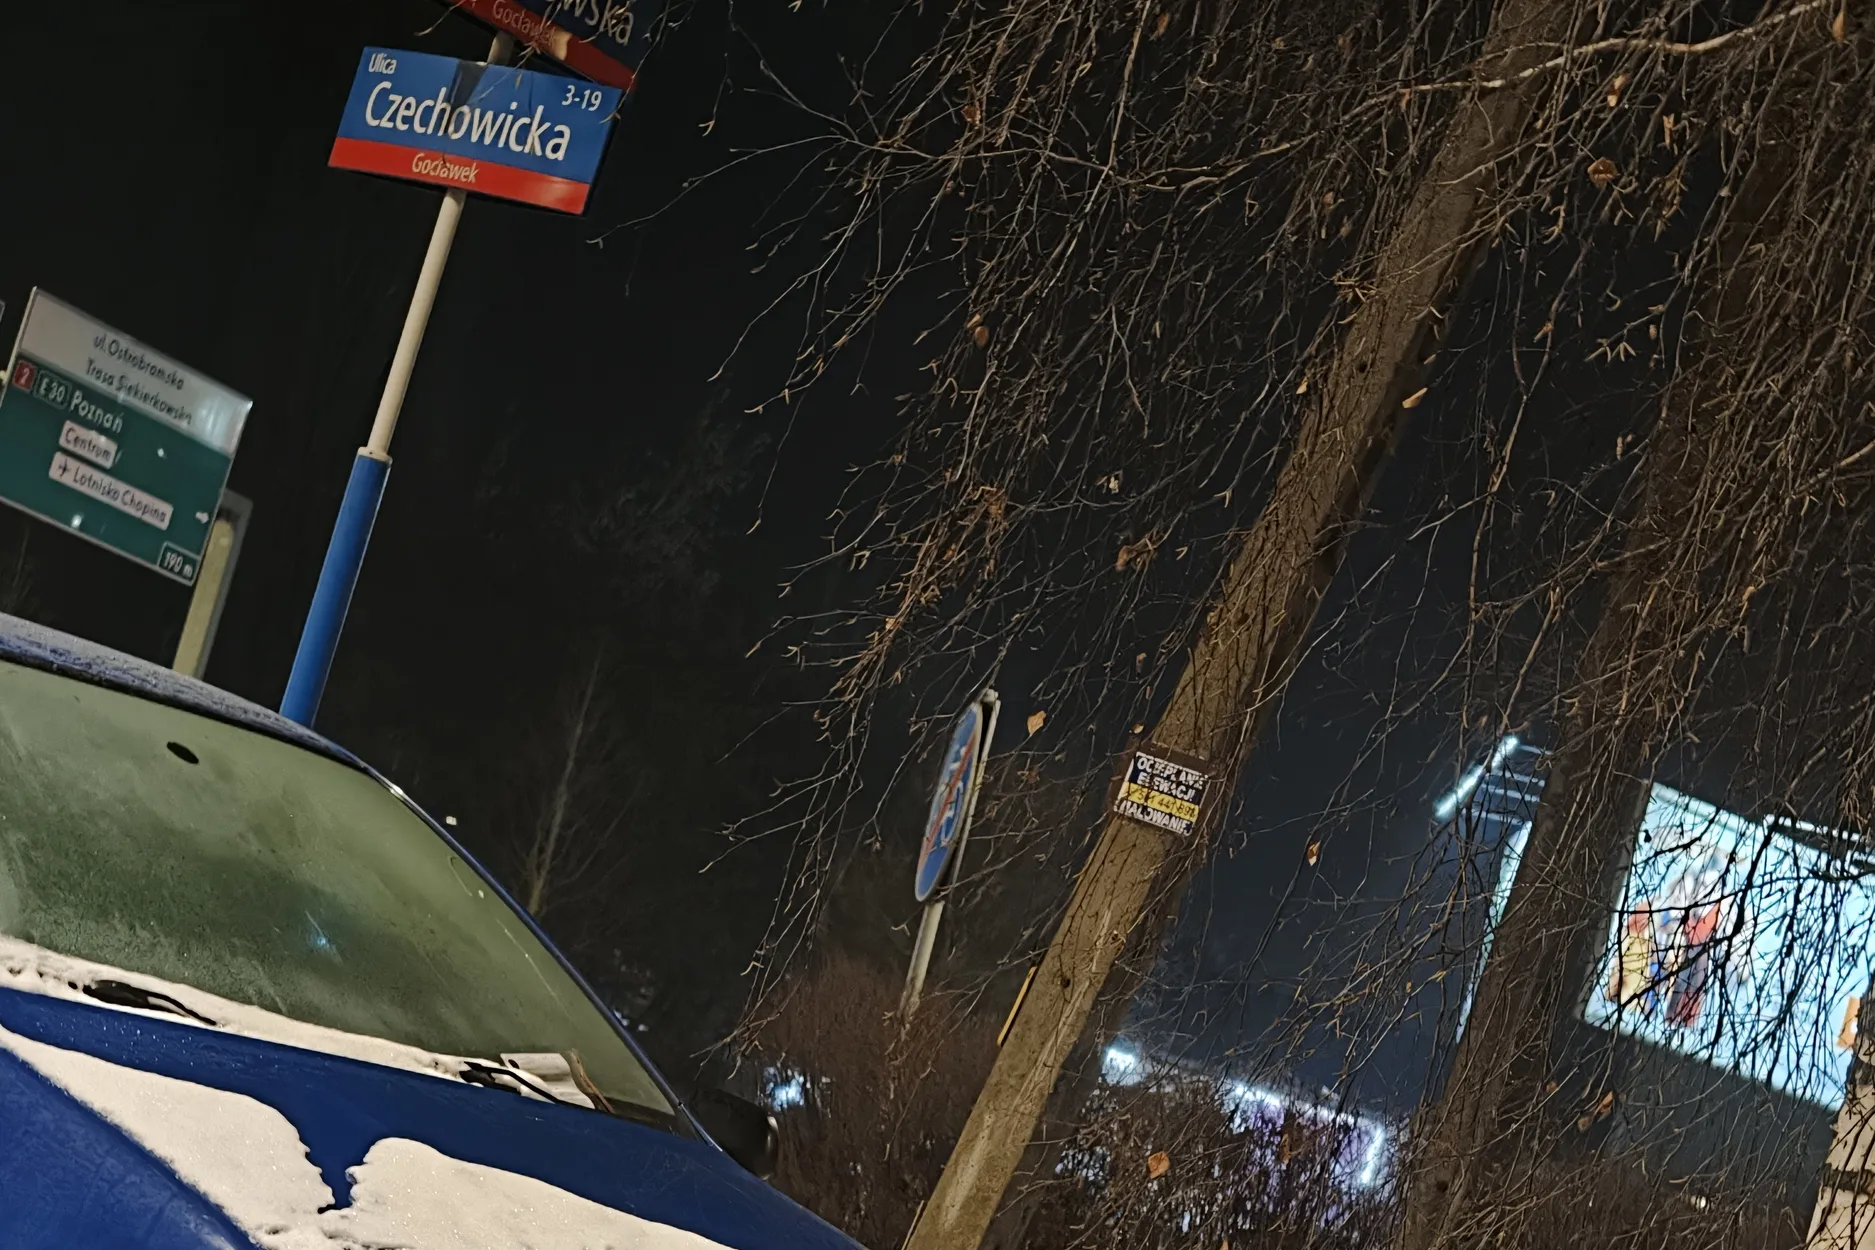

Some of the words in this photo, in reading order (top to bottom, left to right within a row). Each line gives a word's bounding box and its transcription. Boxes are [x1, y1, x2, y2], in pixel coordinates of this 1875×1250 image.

[368, 52, 397, 74] Ulica
[561, 84, 602, 111] 3-19
[365, 81, 571, 161] Czechowicka
[86, 357, 115, 386] Trasa
[108, 339, 185, 390] Ostrobramska
[20, 367, 31, 385] 2
[48, 381, 66, 402] 30
[70, 389, 125, 433] Poznań
[65, 427, 112, 461] Centrum
[73, 466, 120, 501] Lotnisko
[120, 489, 167, 523] Chopina
[163, 551, 183, 573] 190
[182, 564, 193, 578] m
